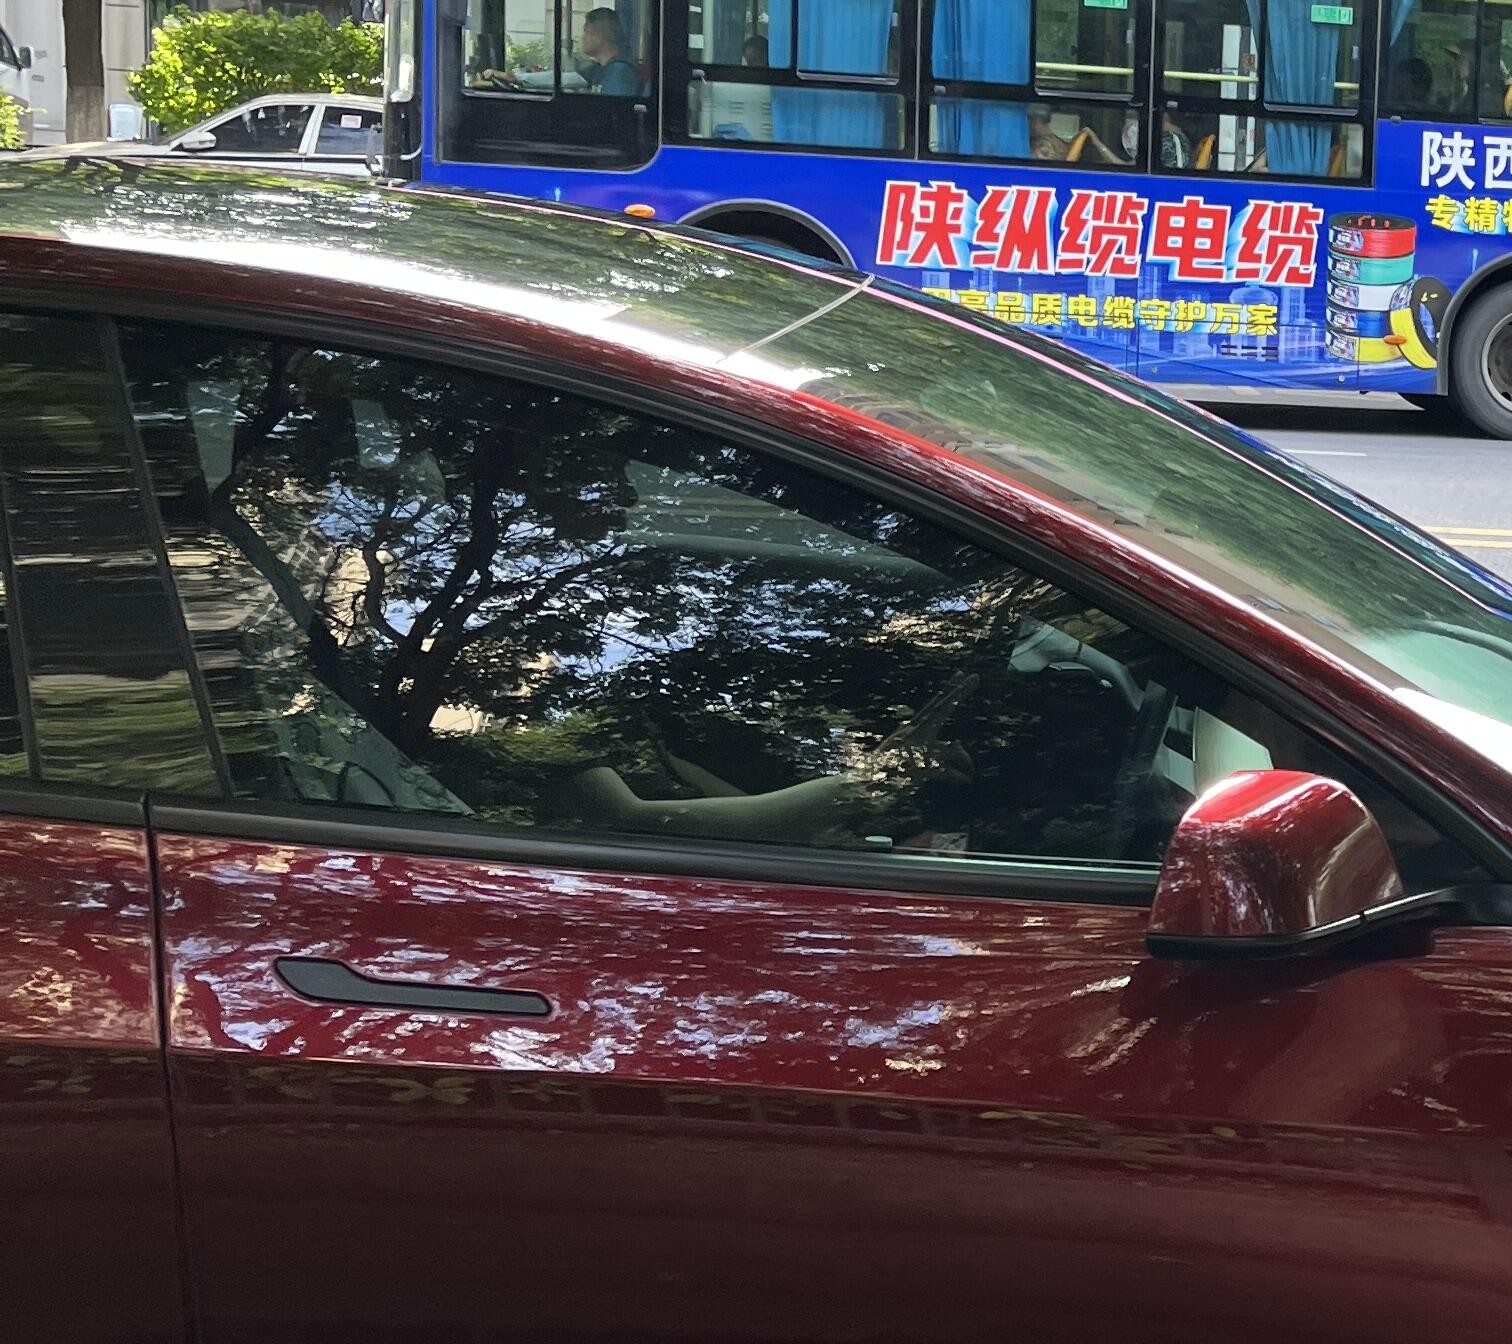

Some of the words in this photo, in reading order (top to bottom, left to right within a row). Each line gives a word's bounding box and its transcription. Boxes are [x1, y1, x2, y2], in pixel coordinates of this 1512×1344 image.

[876, 181, 1324, 287] 陕纵缆电缆
